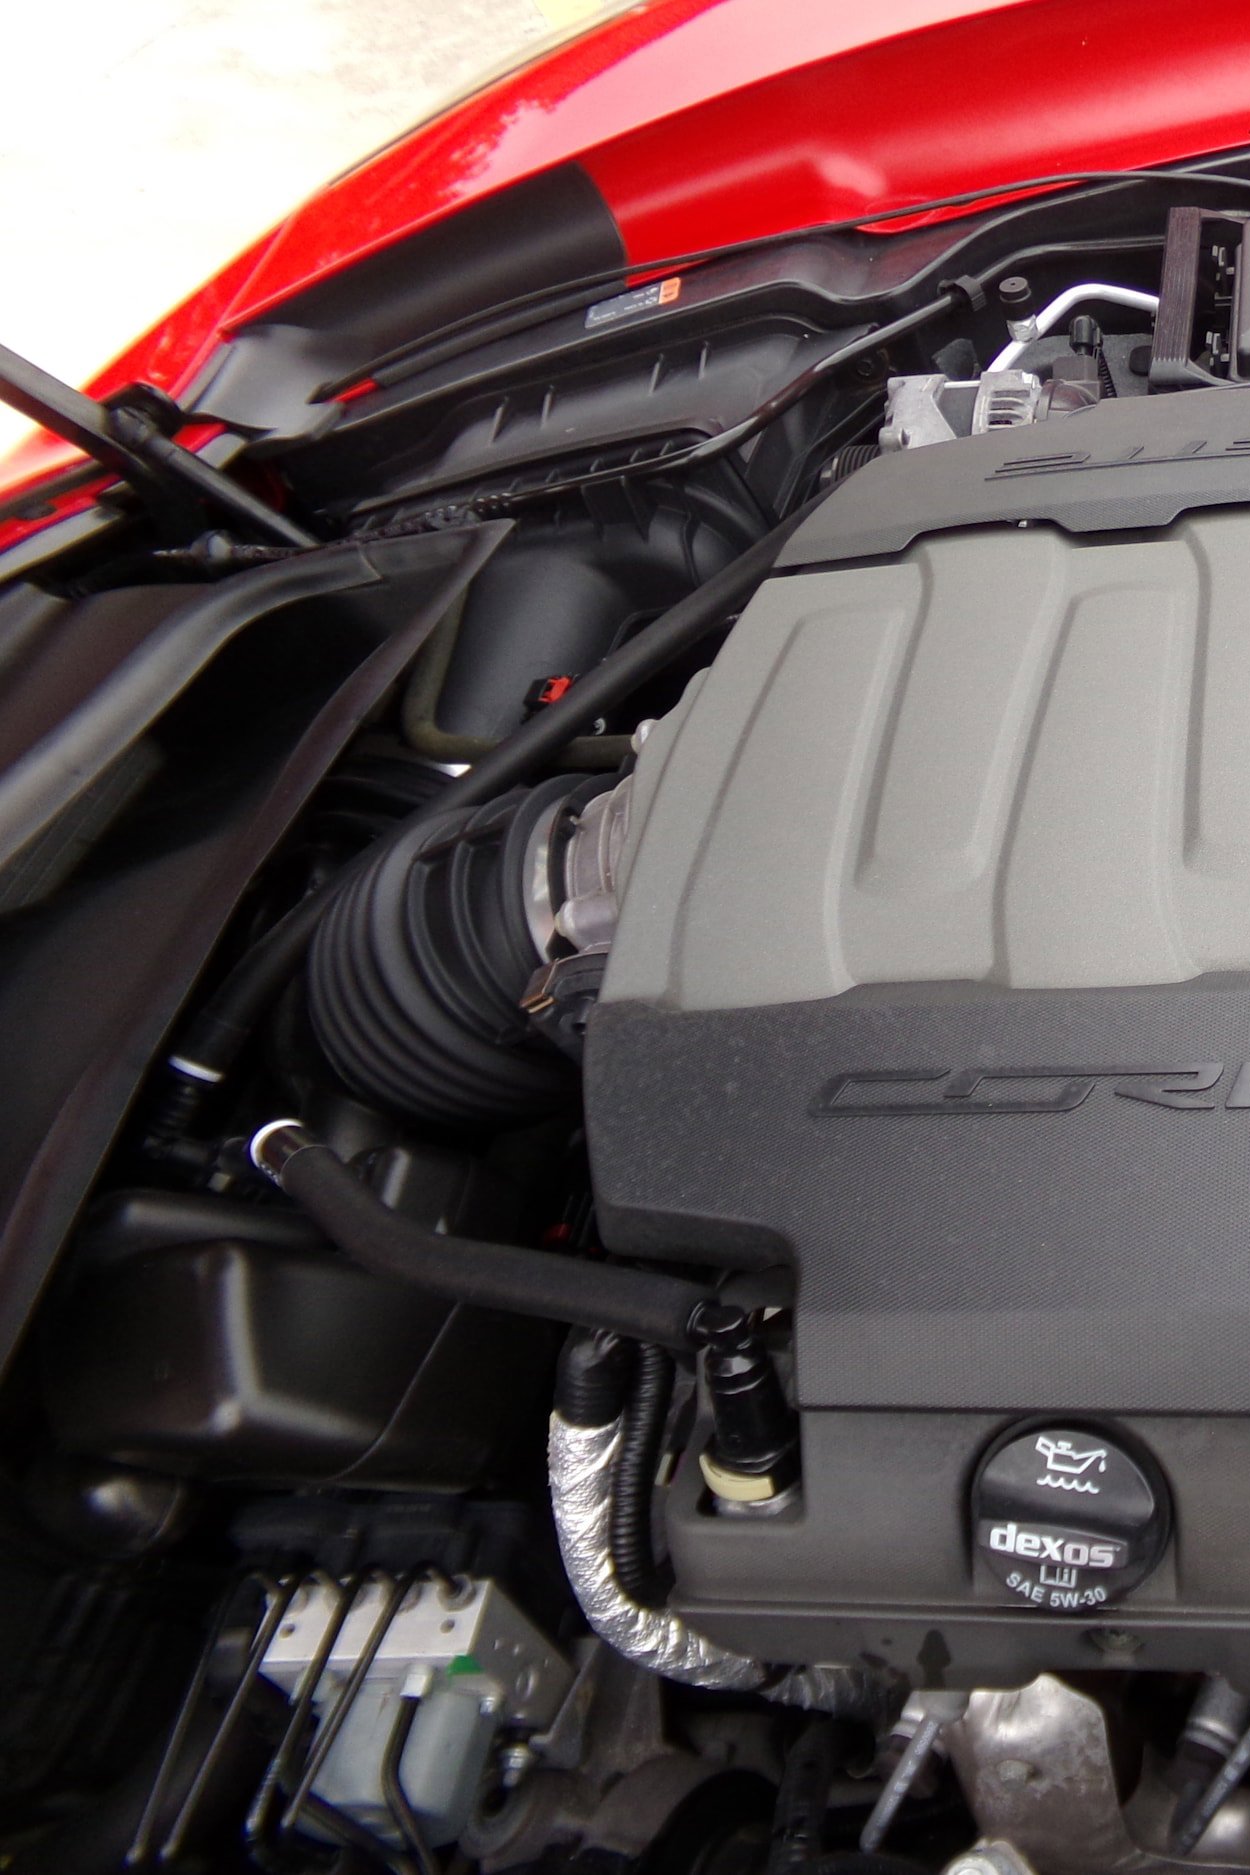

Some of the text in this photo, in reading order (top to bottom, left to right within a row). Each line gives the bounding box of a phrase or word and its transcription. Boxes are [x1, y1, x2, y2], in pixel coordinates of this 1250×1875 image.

[989, 1523, 1114, 1568] dexos
[1006, 1571, 1107, 1609] SAE 5W-30
